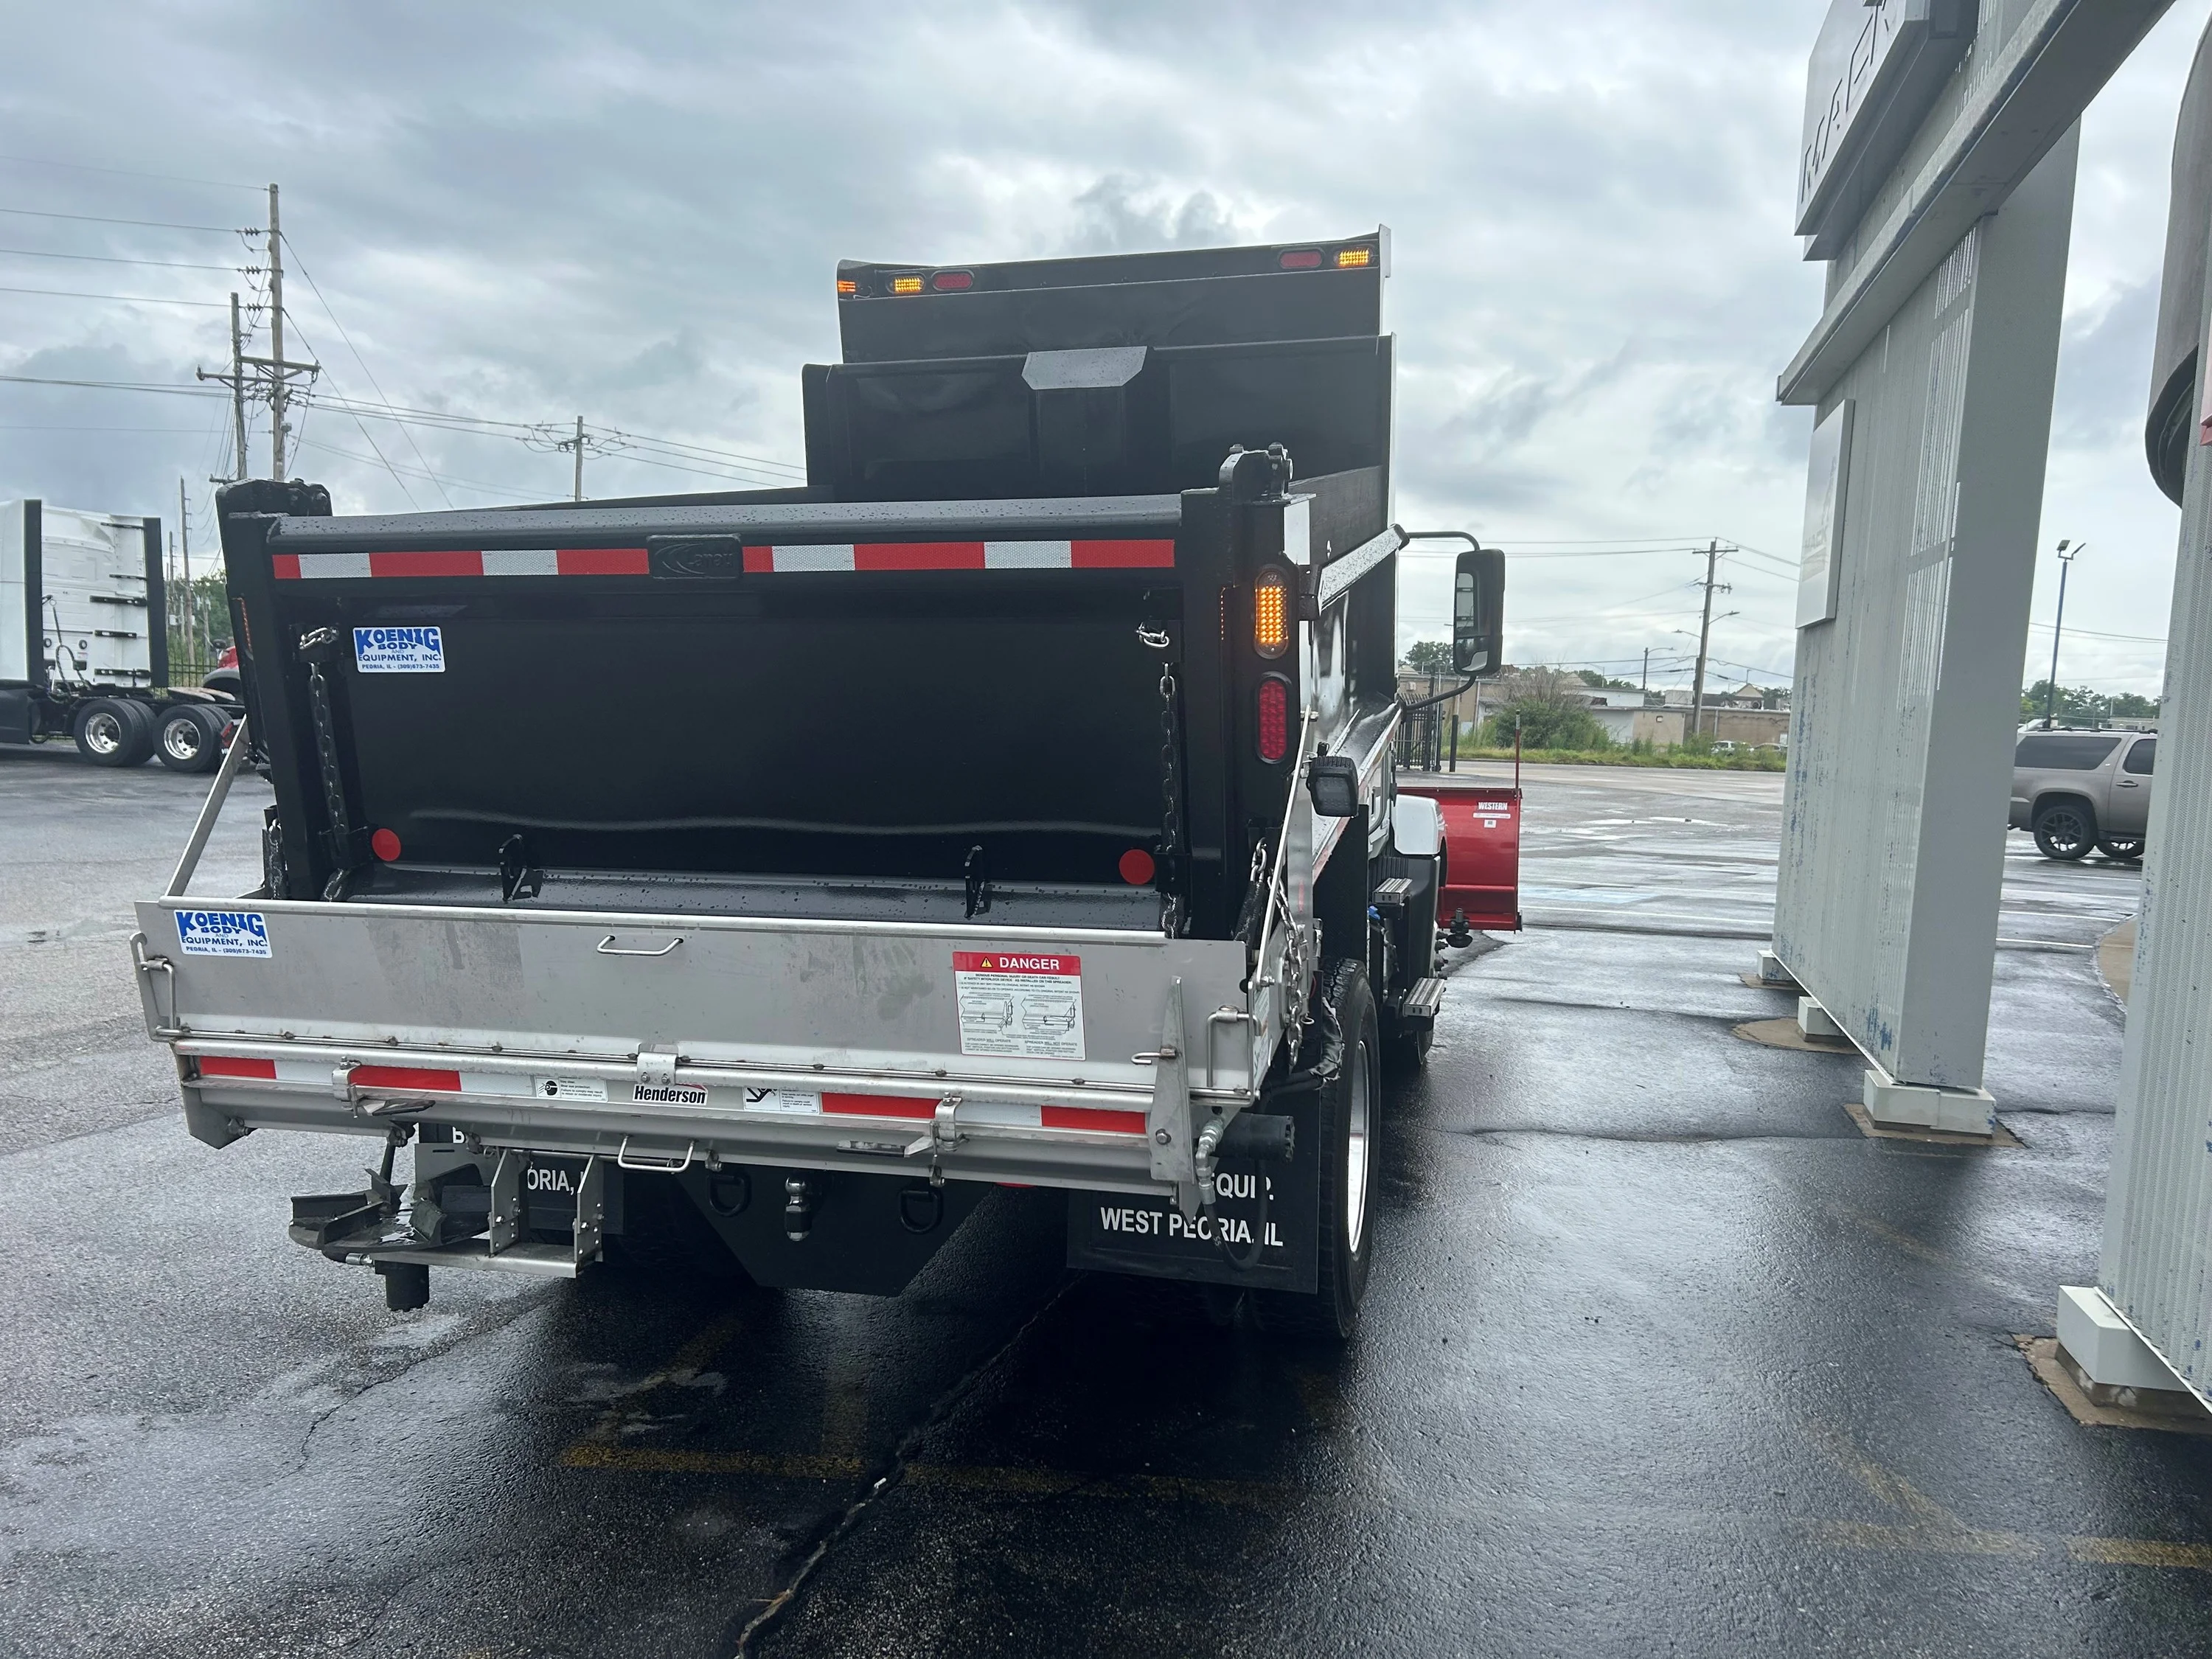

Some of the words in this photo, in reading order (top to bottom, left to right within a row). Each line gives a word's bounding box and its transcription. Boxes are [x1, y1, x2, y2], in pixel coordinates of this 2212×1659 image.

[355, 628, 441, 655] KOENIG
[1478, 801, 1508, 810] WESTERN
[175, 911, 267, 942] KOENIG
[201, 925, 243, 934] BODY
[181, 936, 243, 946] EQUIPMENT,
[999, 957, 1060, 970] DANGER
[634, 1085, 706, 1104] Henderson
[527, 1168, 574, 1195] ORIA,
[1211, 1172, 1274, 1200] QUI.
[1101, 1207, 1163, 1235] WEST
[1264, 1222, 1284, 1247] IL
